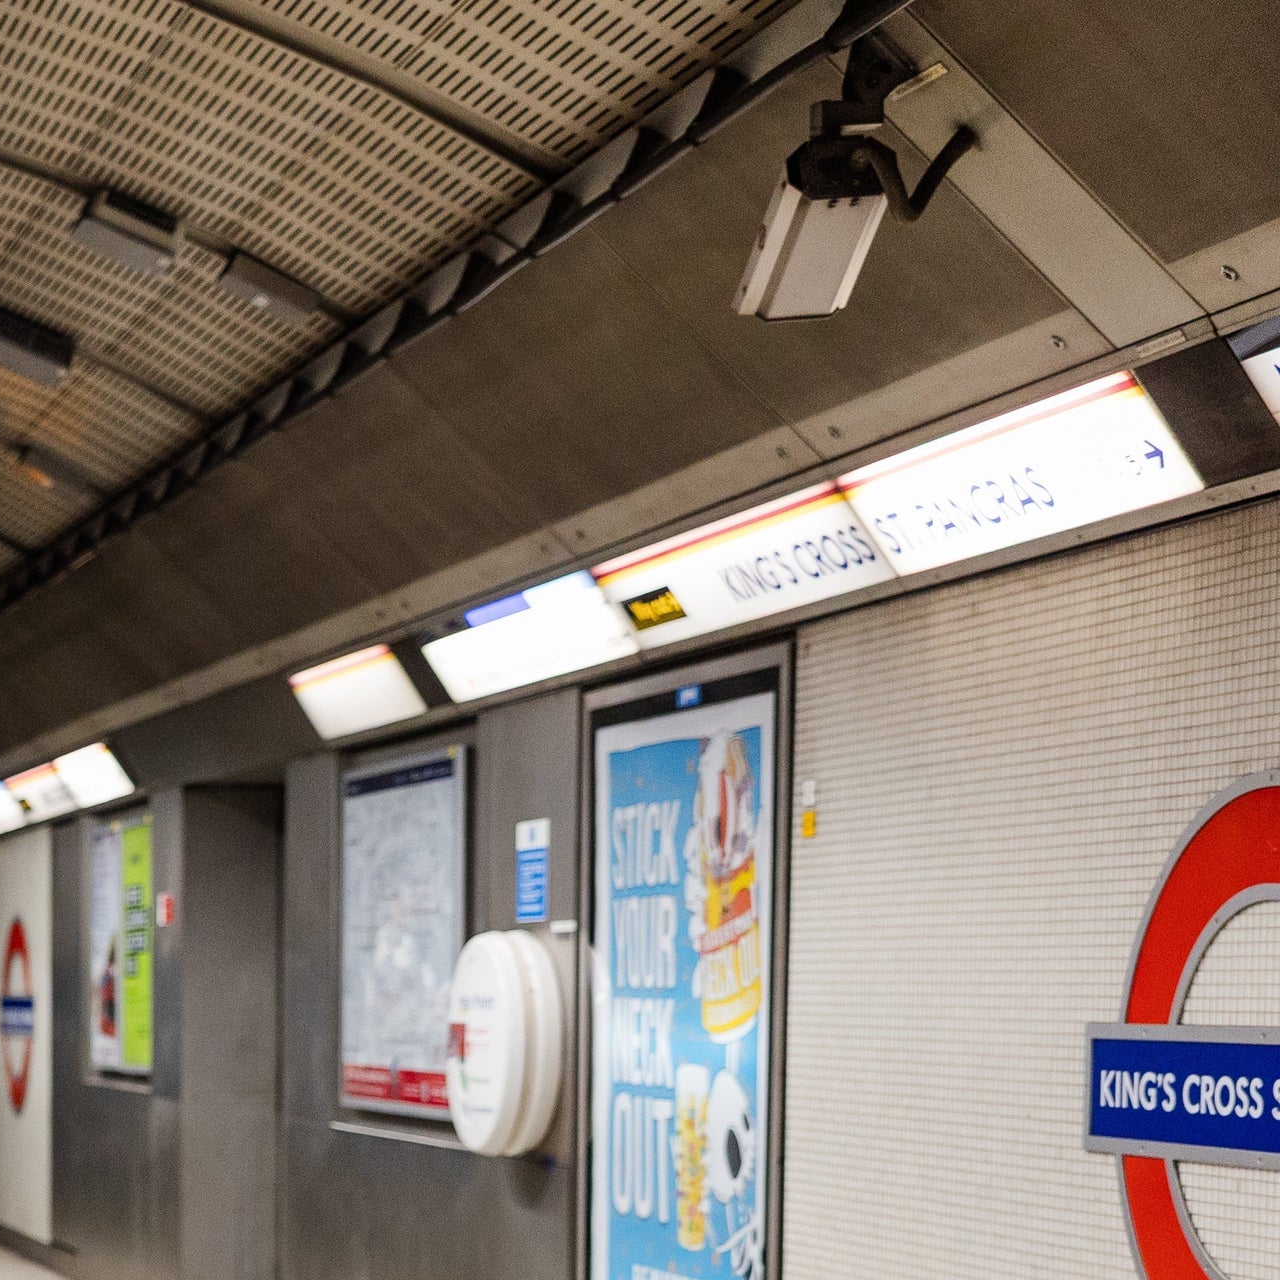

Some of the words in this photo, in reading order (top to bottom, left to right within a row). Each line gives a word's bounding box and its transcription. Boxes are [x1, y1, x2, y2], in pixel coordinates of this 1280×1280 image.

[719, 549, 798, 602] KING'S
[792, 524, 876, 579] CROSS
[915, 466, 1056, 542] PANCRAS
[612, 800, 680, 890] STICK
[612, 895, 677, 989] YOUR
[612, 996, 675, 1089] NECK
[1100, 1069, 1177, 1113] KING'S
[1182, 1074, 1264, 1120] CROSS
[611, 1092, 672, 1224] OUT
